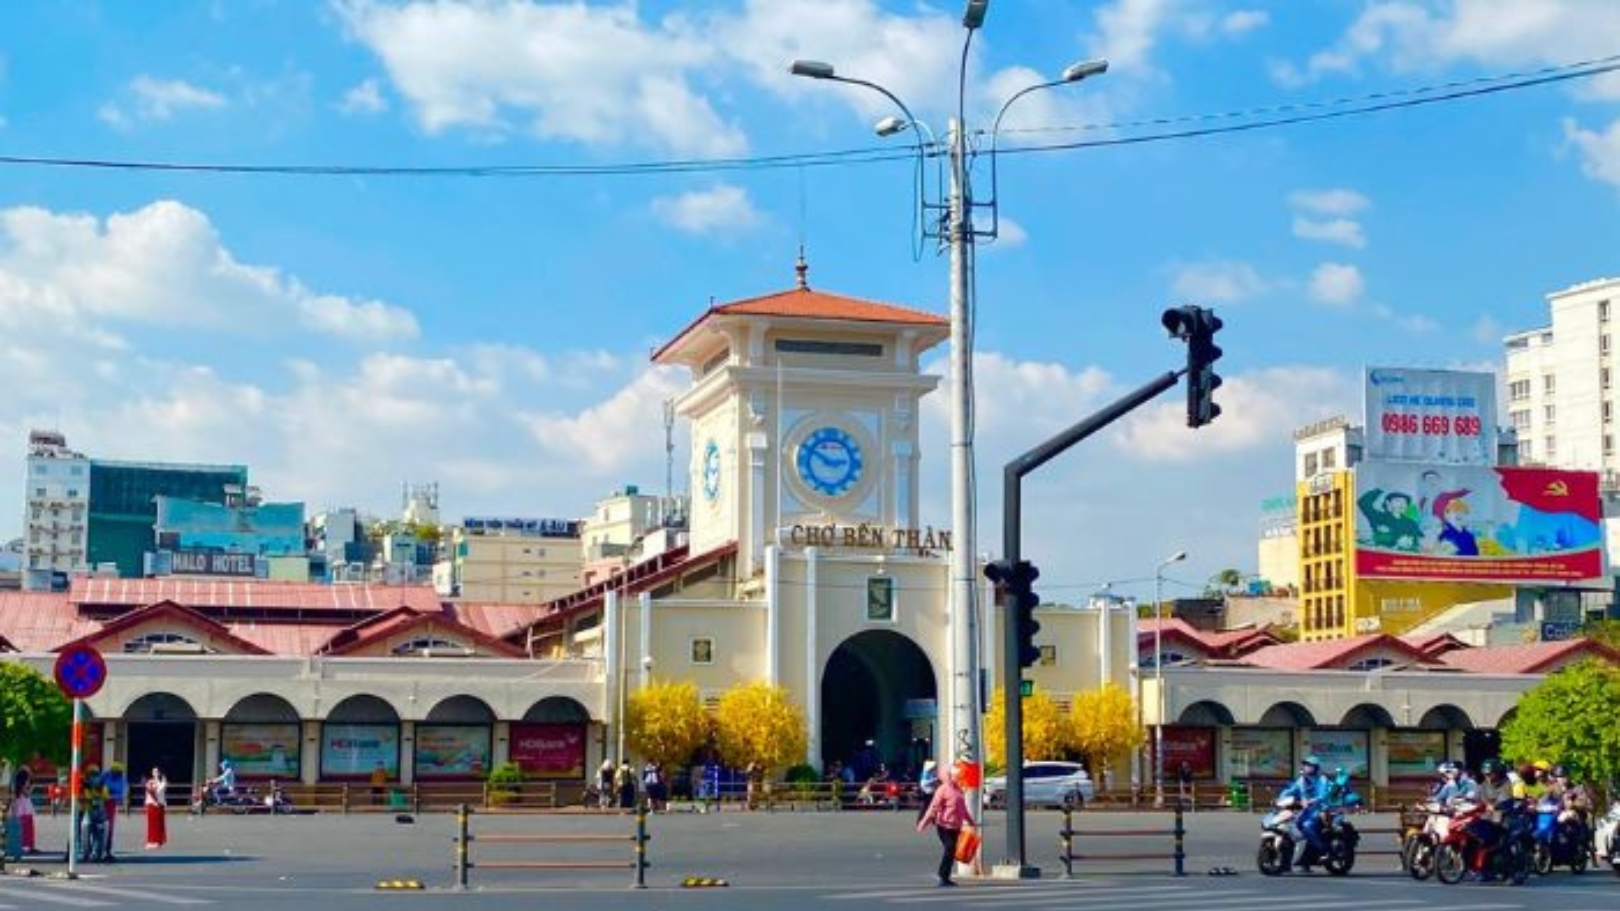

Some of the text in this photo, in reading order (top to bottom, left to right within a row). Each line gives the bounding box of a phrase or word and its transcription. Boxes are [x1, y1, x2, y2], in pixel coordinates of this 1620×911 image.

[1382, 413, 1481, 436] 0986 669 689
[791, 521, 953, 551] CHỢ BẾN THÀN
[212, 554, 254, 573] HOTEL
